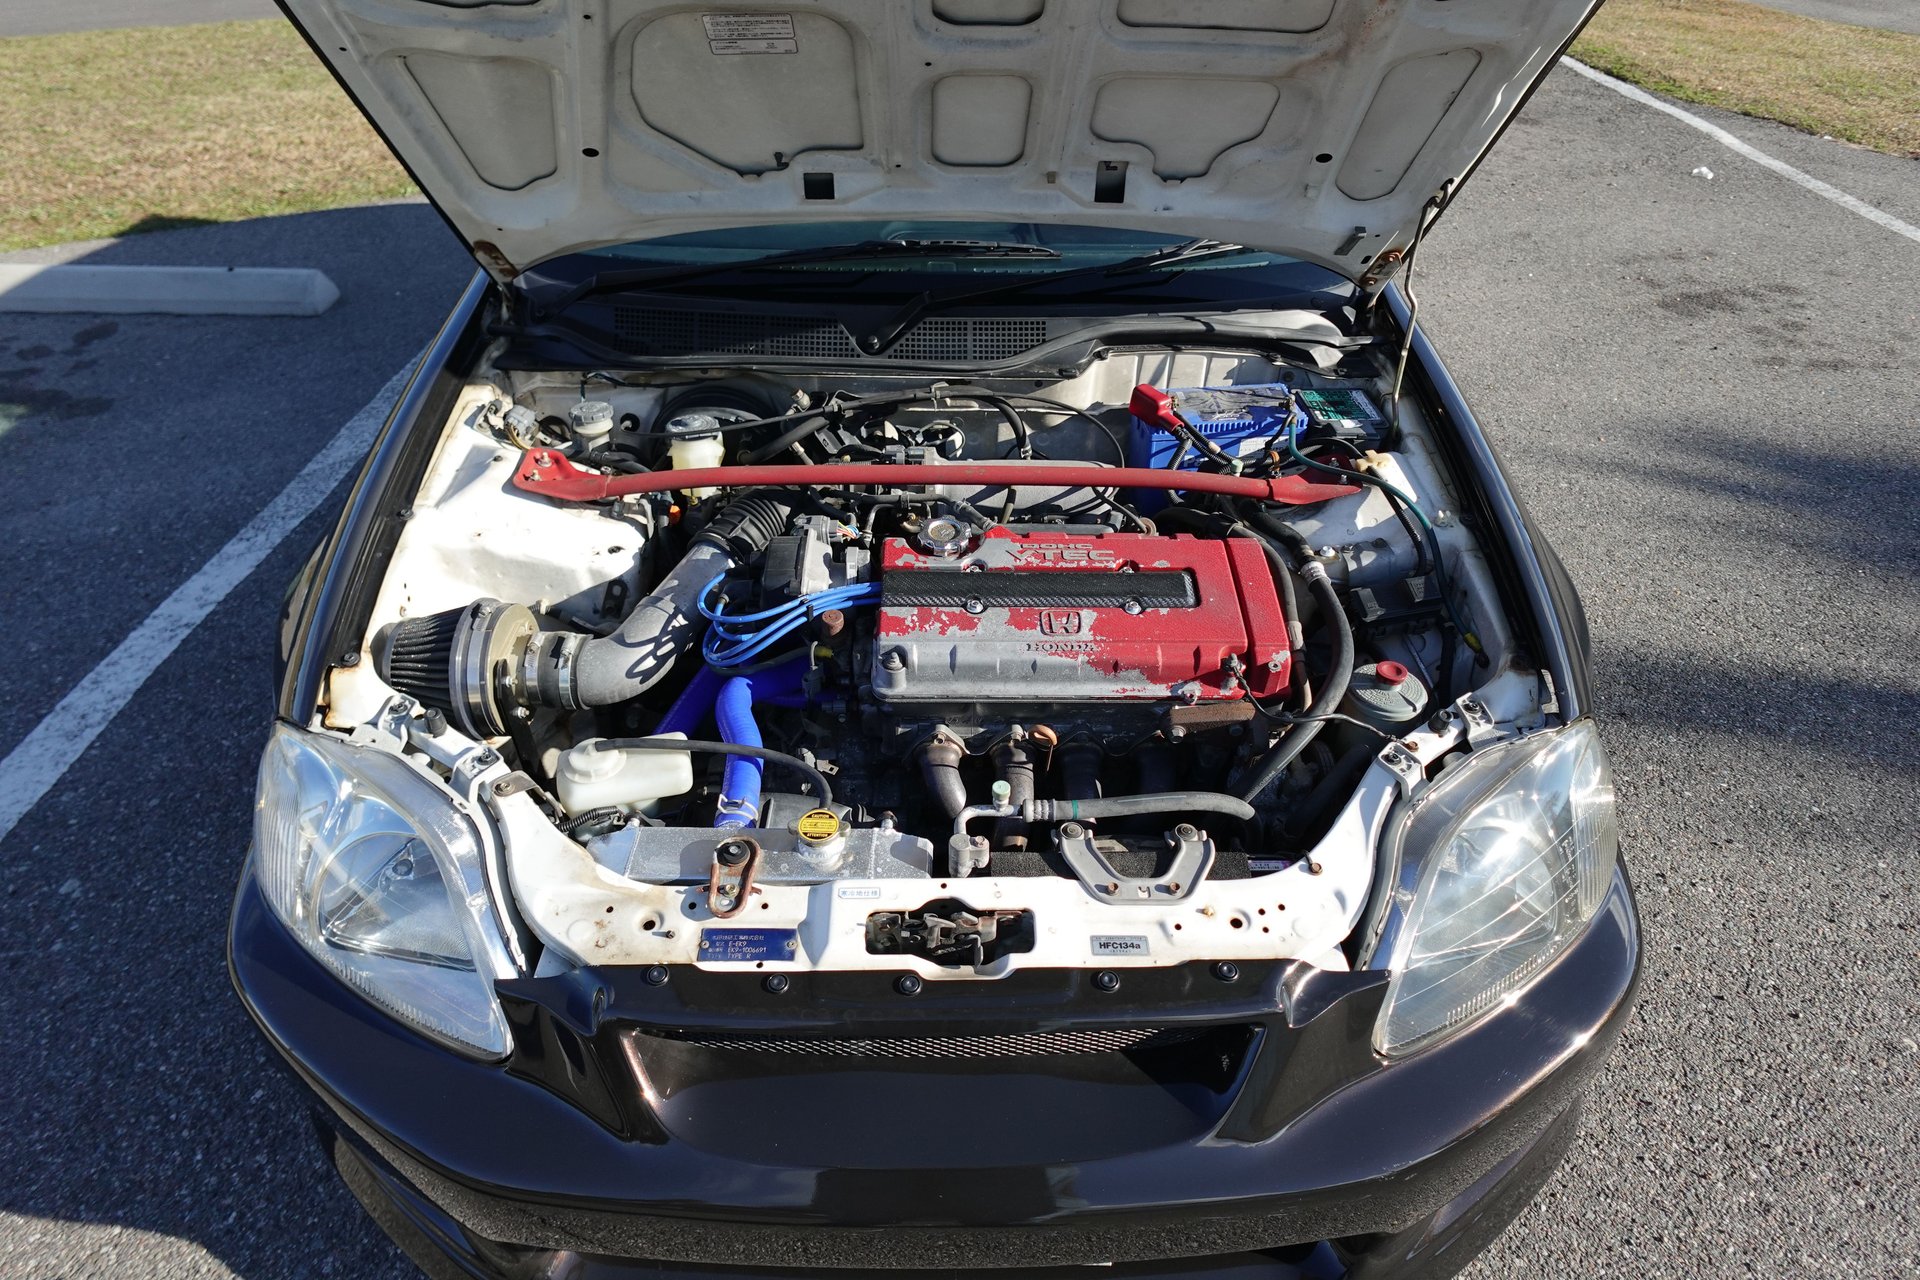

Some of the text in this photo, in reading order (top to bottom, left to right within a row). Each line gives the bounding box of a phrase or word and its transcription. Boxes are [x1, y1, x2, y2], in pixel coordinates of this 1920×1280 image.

[1005, 549, 1115, 561] VTEC
[1026, 642, 1099, 652] HONDA
[1099, 941, 1141, 949] HFC134a
